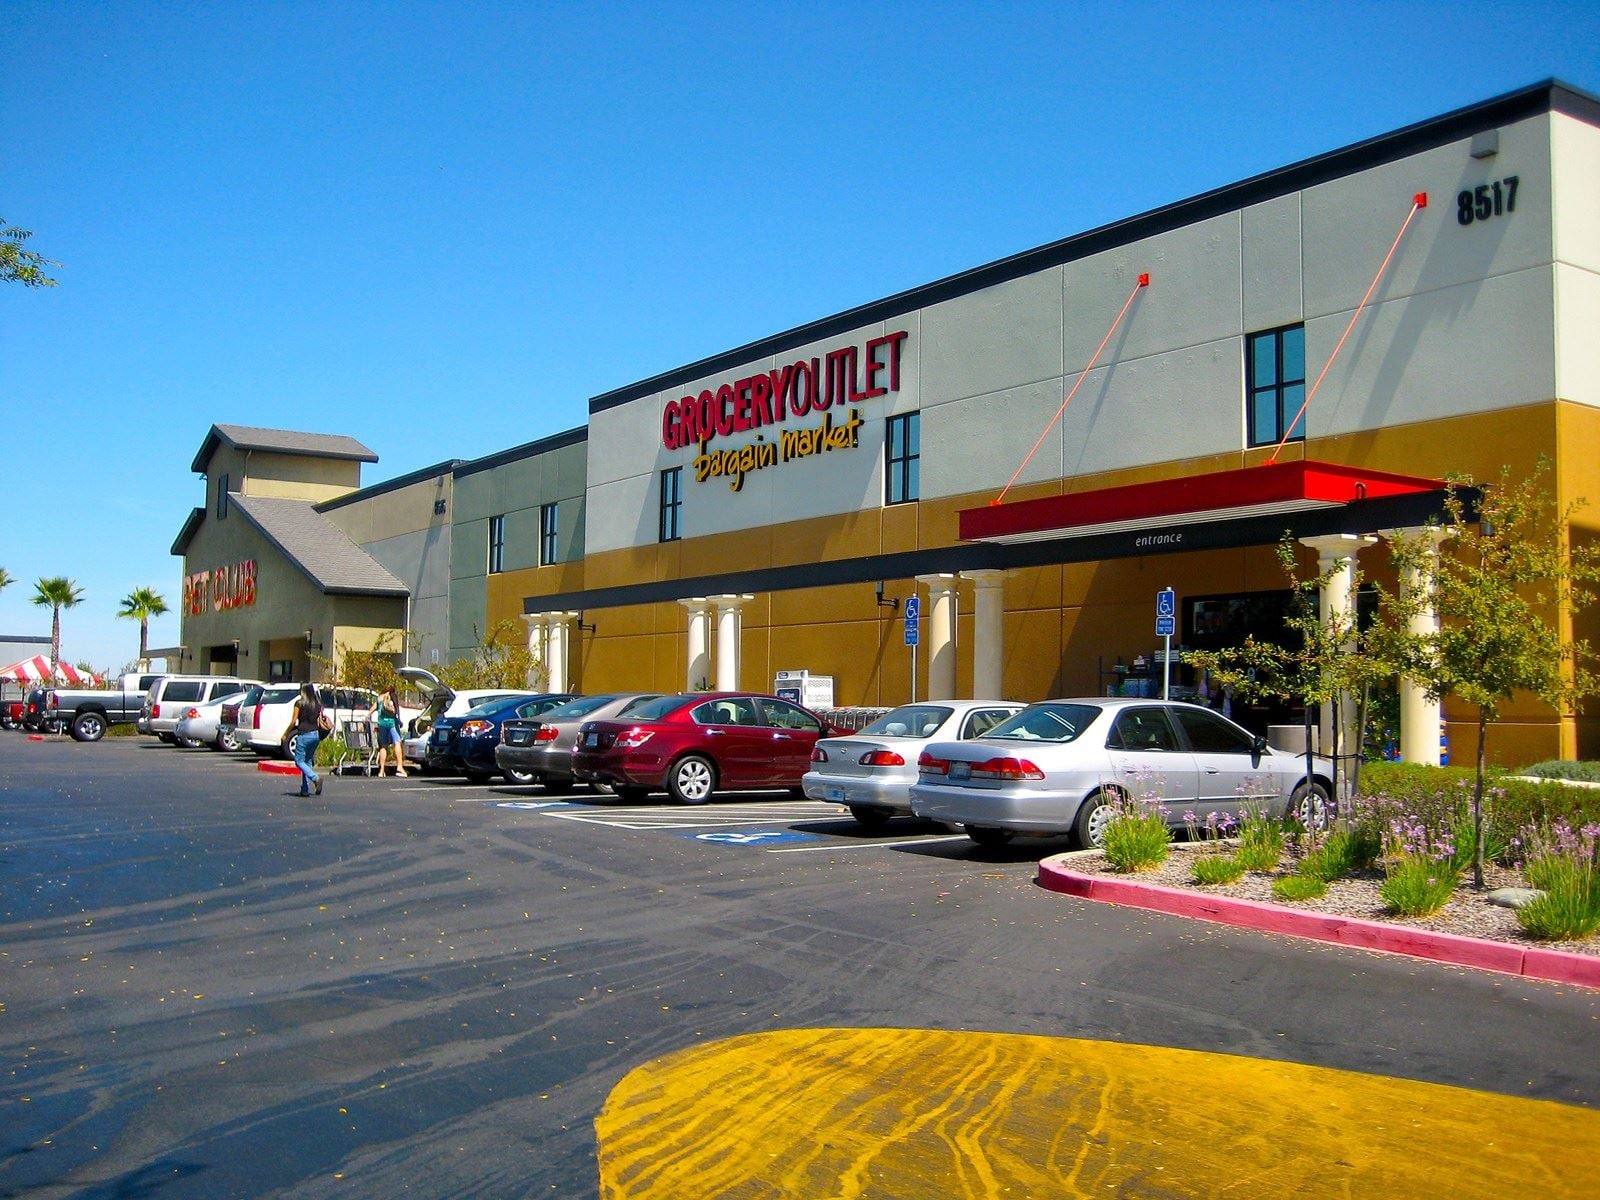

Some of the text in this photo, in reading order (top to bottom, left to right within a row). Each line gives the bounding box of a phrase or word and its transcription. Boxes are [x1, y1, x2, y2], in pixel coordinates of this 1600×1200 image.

[1457, 175, 1520, 226] 8517
[693, 409, 864, 492] bargain market
[1135, 533, 1182, 547] entrance
[184, 560, 257, 617] PET CLUB
